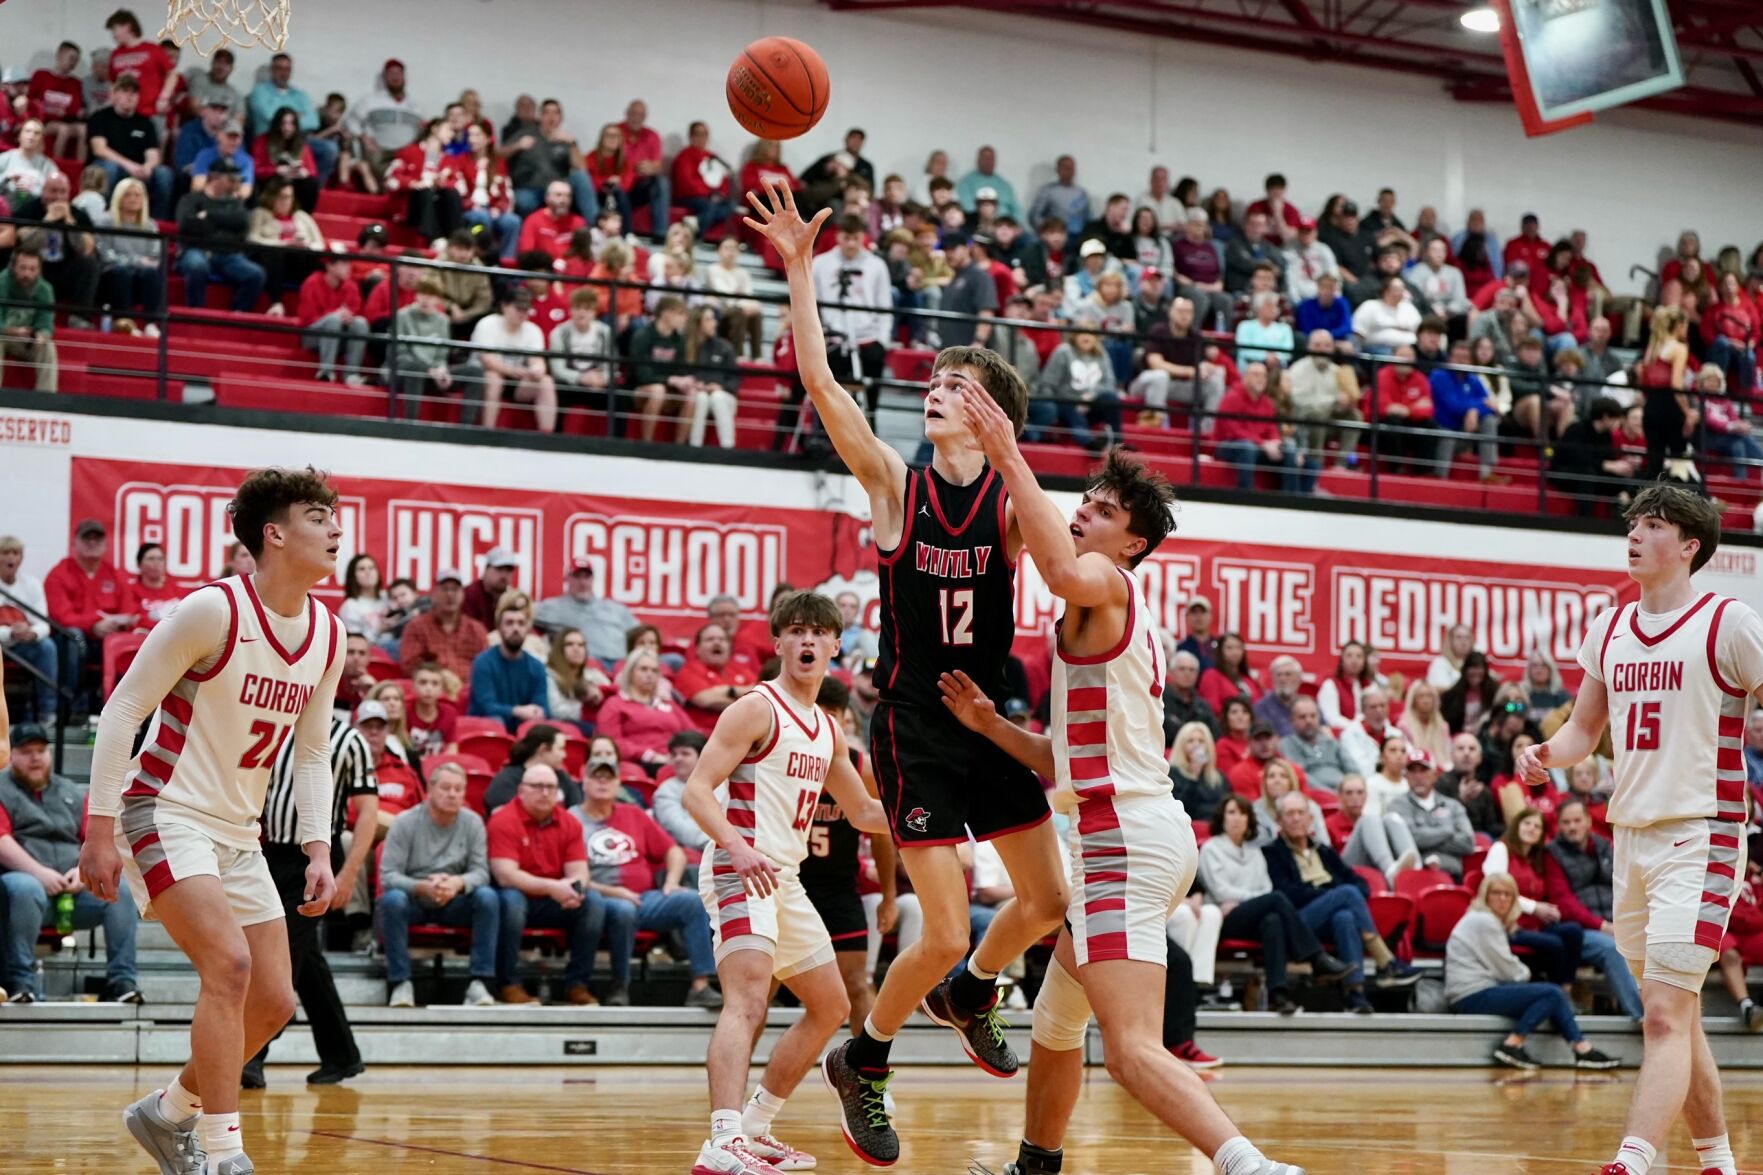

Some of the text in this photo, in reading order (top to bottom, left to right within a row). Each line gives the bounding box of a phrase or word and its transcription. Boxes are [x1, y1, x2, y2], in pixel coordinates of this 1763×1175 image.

[939, 588, 974, 645] 12
[1220, 567, 1308, 644] THE
[239, 673, 315, 715] CORBIN
[1613, 661, 1684, 692] CORBIN
[237, 719, 293, 769] 21
[1625, 701, 1662, 752] 15
